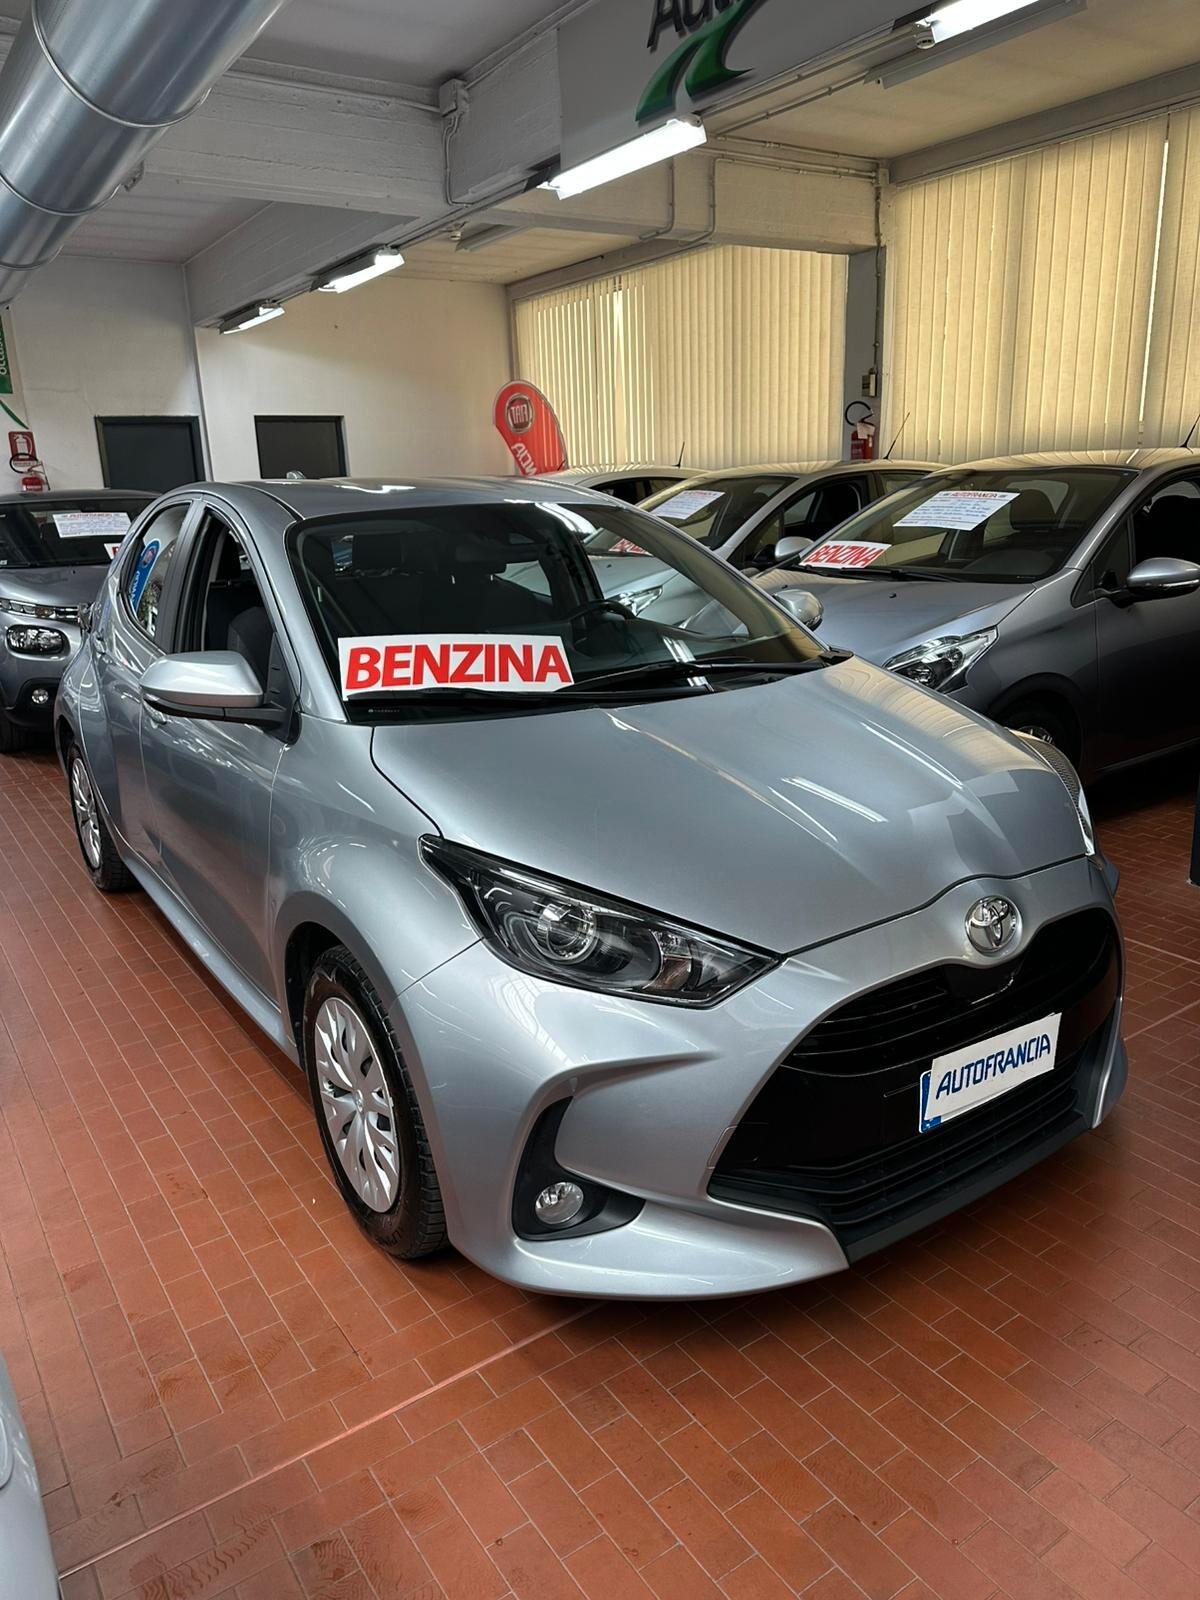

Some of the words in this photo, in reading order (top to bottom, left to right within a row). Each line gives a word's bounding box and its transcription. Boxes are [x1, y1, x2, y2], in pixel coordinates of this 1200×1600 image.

[803, 545, 885, 567] BENZINA
[345, 643, 573, 690] BENZINA
[935, 1033, 1051, 1100] AUTOFRANCIA
